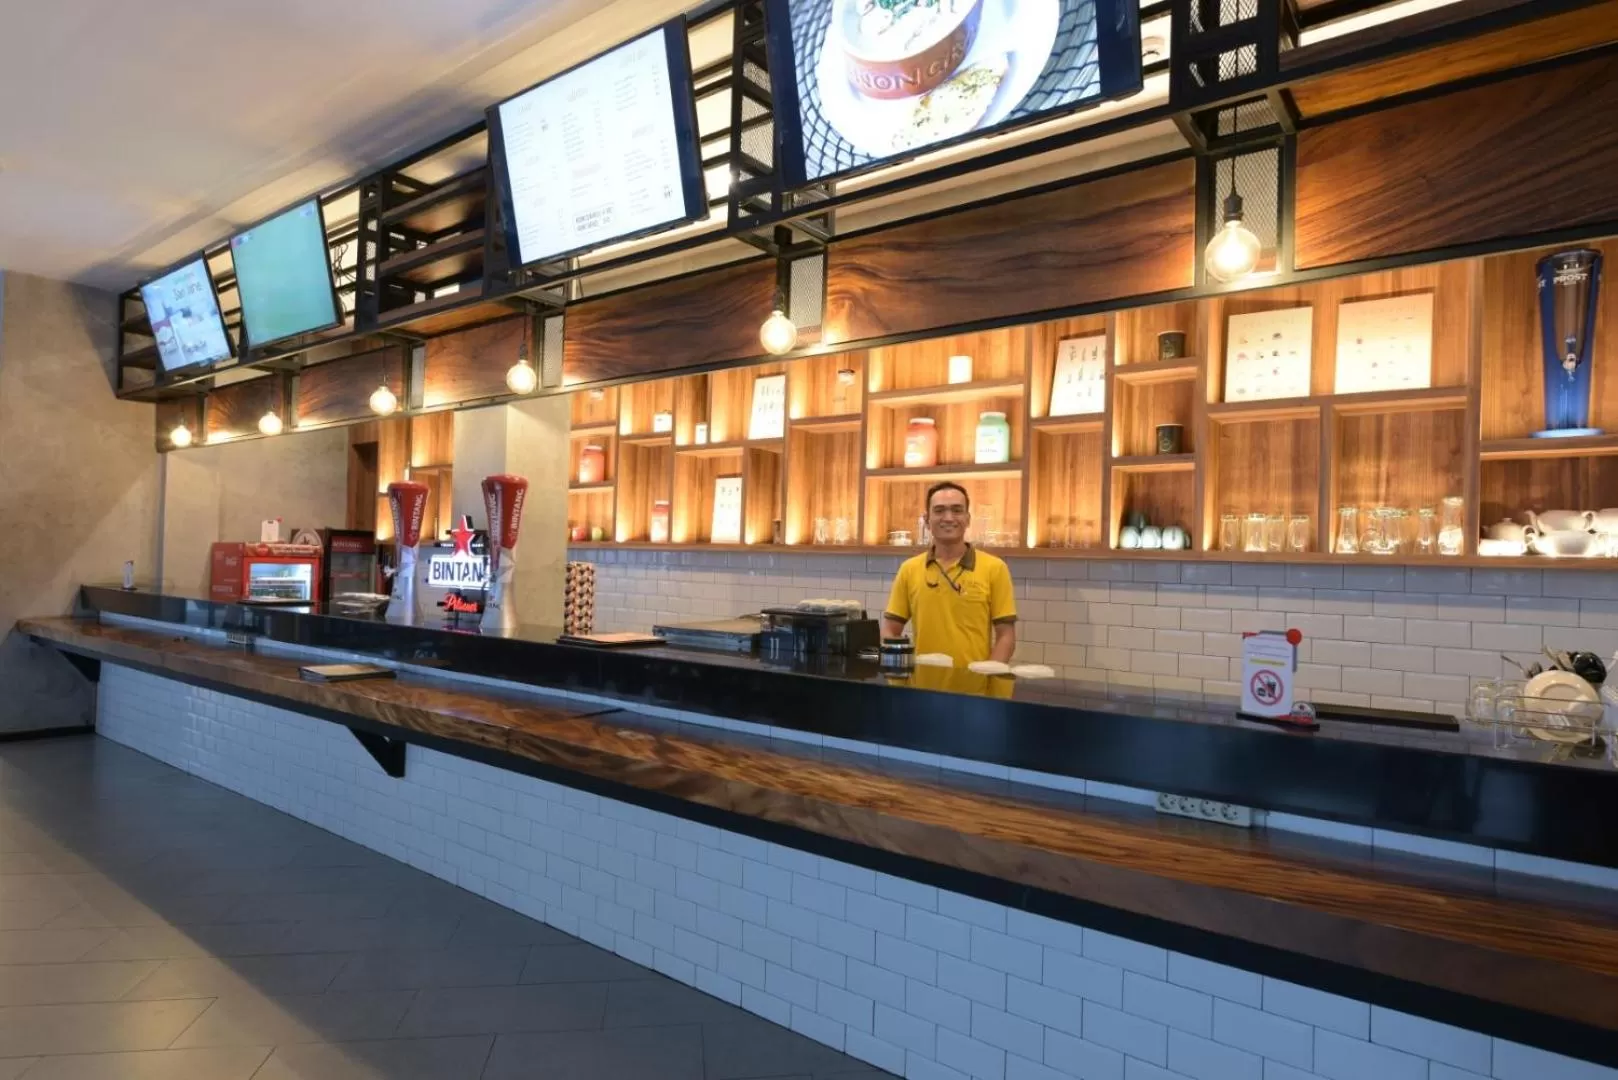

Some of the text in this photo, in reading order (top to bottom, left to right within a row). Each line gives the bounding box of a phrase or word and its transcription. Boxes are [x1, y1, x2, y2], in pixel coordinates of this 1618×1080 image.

[411, 494, 424, 529] BINTANG
[510, 488, 524, 530] BINTANG
[433, 561, 486, 583] BINTAN
